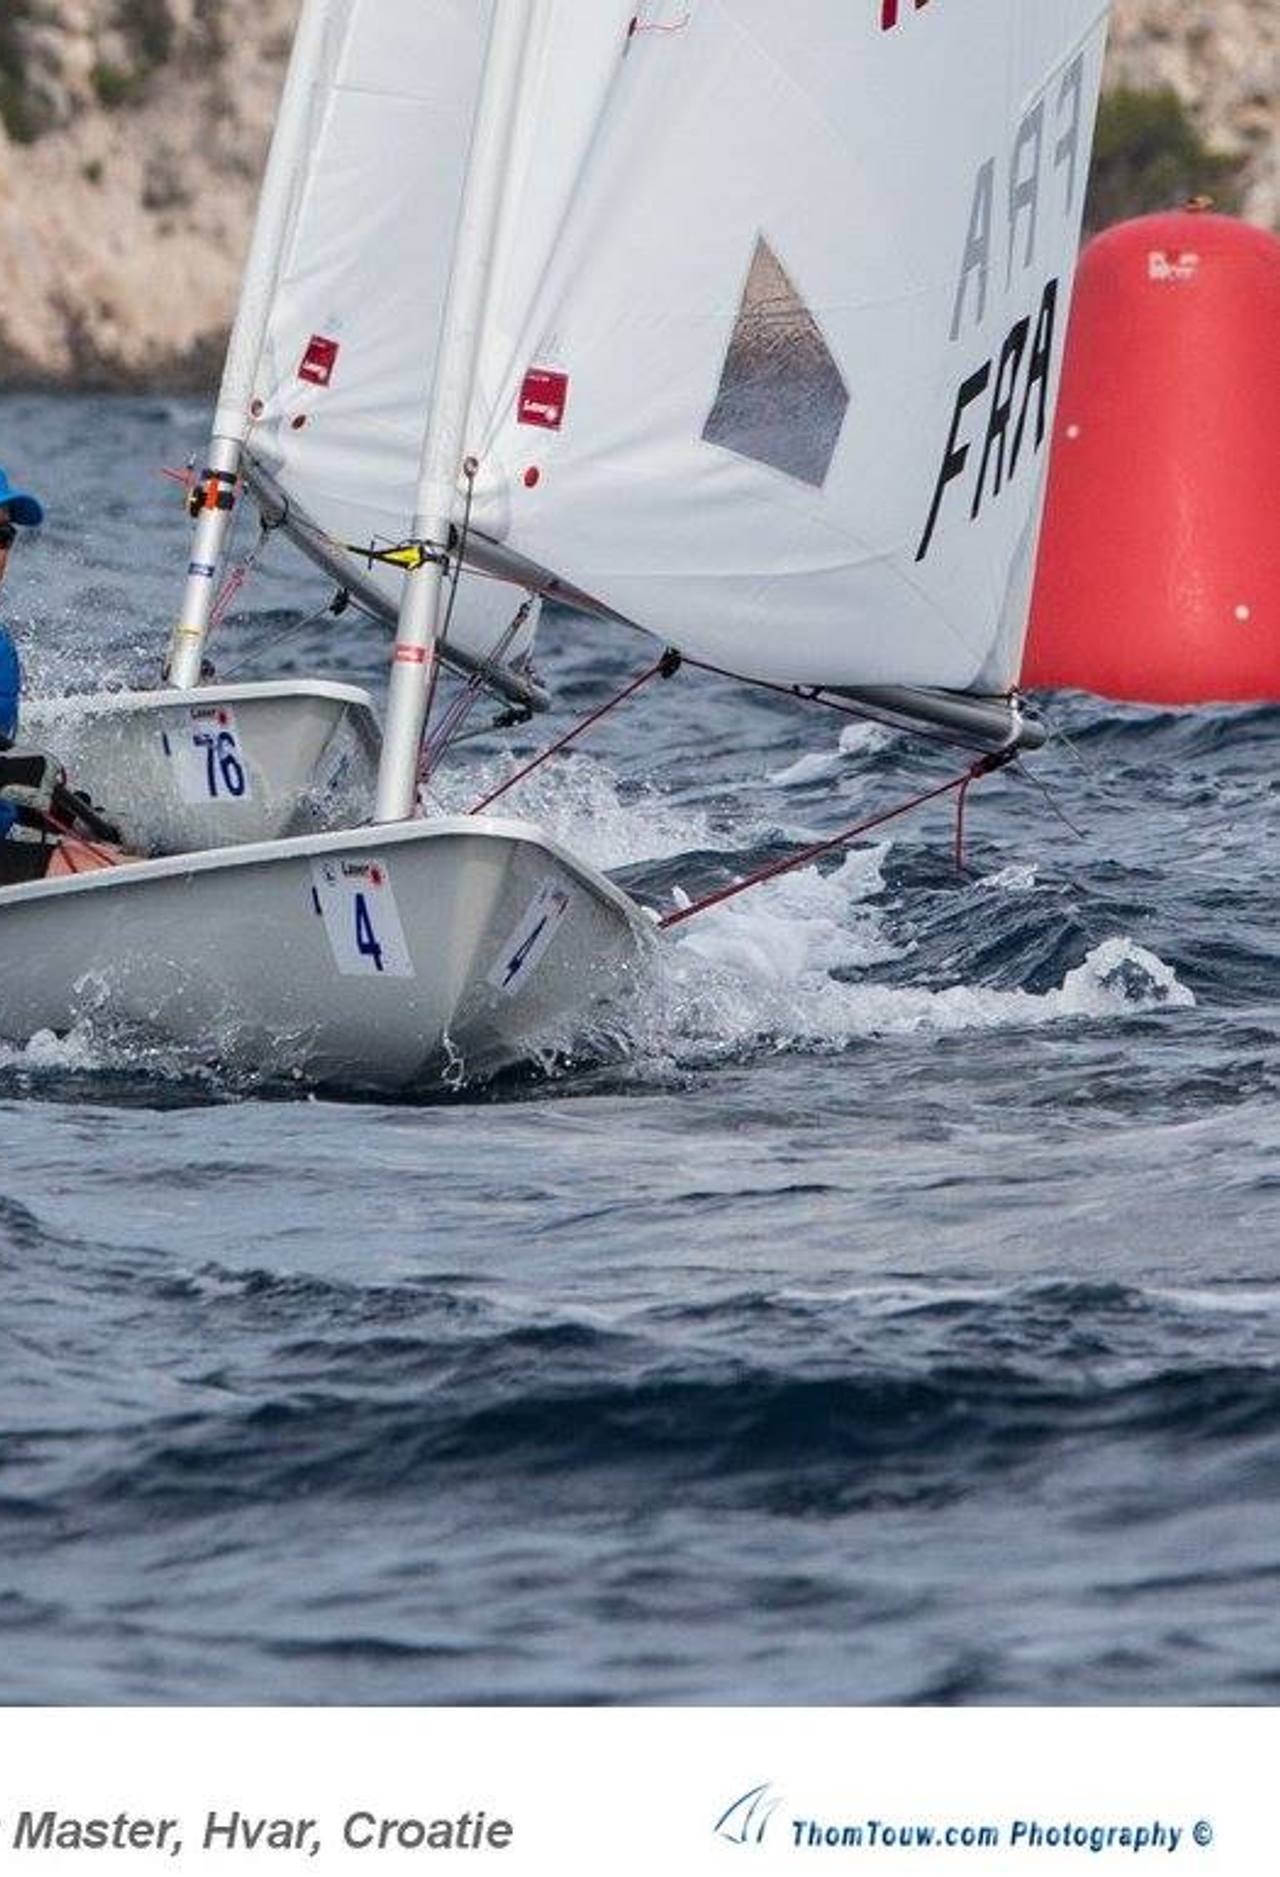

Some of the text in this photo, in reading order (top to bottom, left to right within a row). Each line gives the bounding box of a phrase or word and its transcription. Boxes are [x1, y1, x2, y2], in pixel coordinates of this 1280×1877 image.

[914, 277, 1059, 562] FRA
[192, 732, 245, 797] 76
[355, 892, 384, 971] 4
[502, 916, 547, 987] 4
